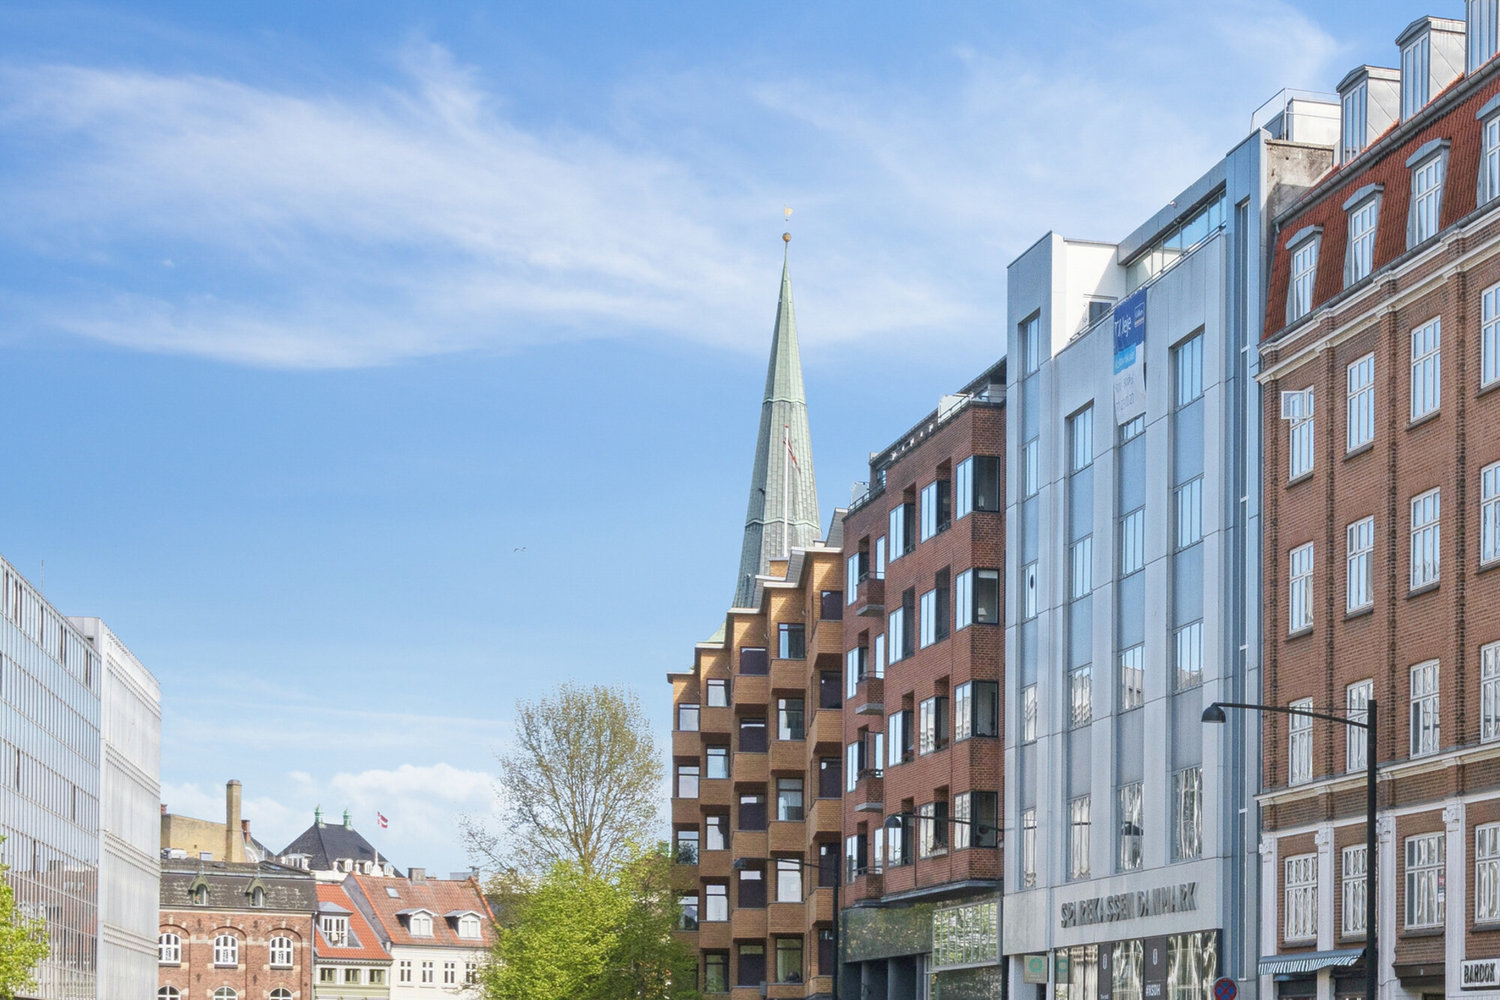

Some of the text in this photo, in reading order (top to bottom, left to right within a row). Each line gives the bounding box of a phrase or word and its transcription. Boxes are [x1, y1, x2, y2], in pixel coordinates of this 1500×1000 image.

[1061, 882, 1197, 929] SPAREKASSEN DANMARK
[1464, 963, 1495, 984] BARDOK
